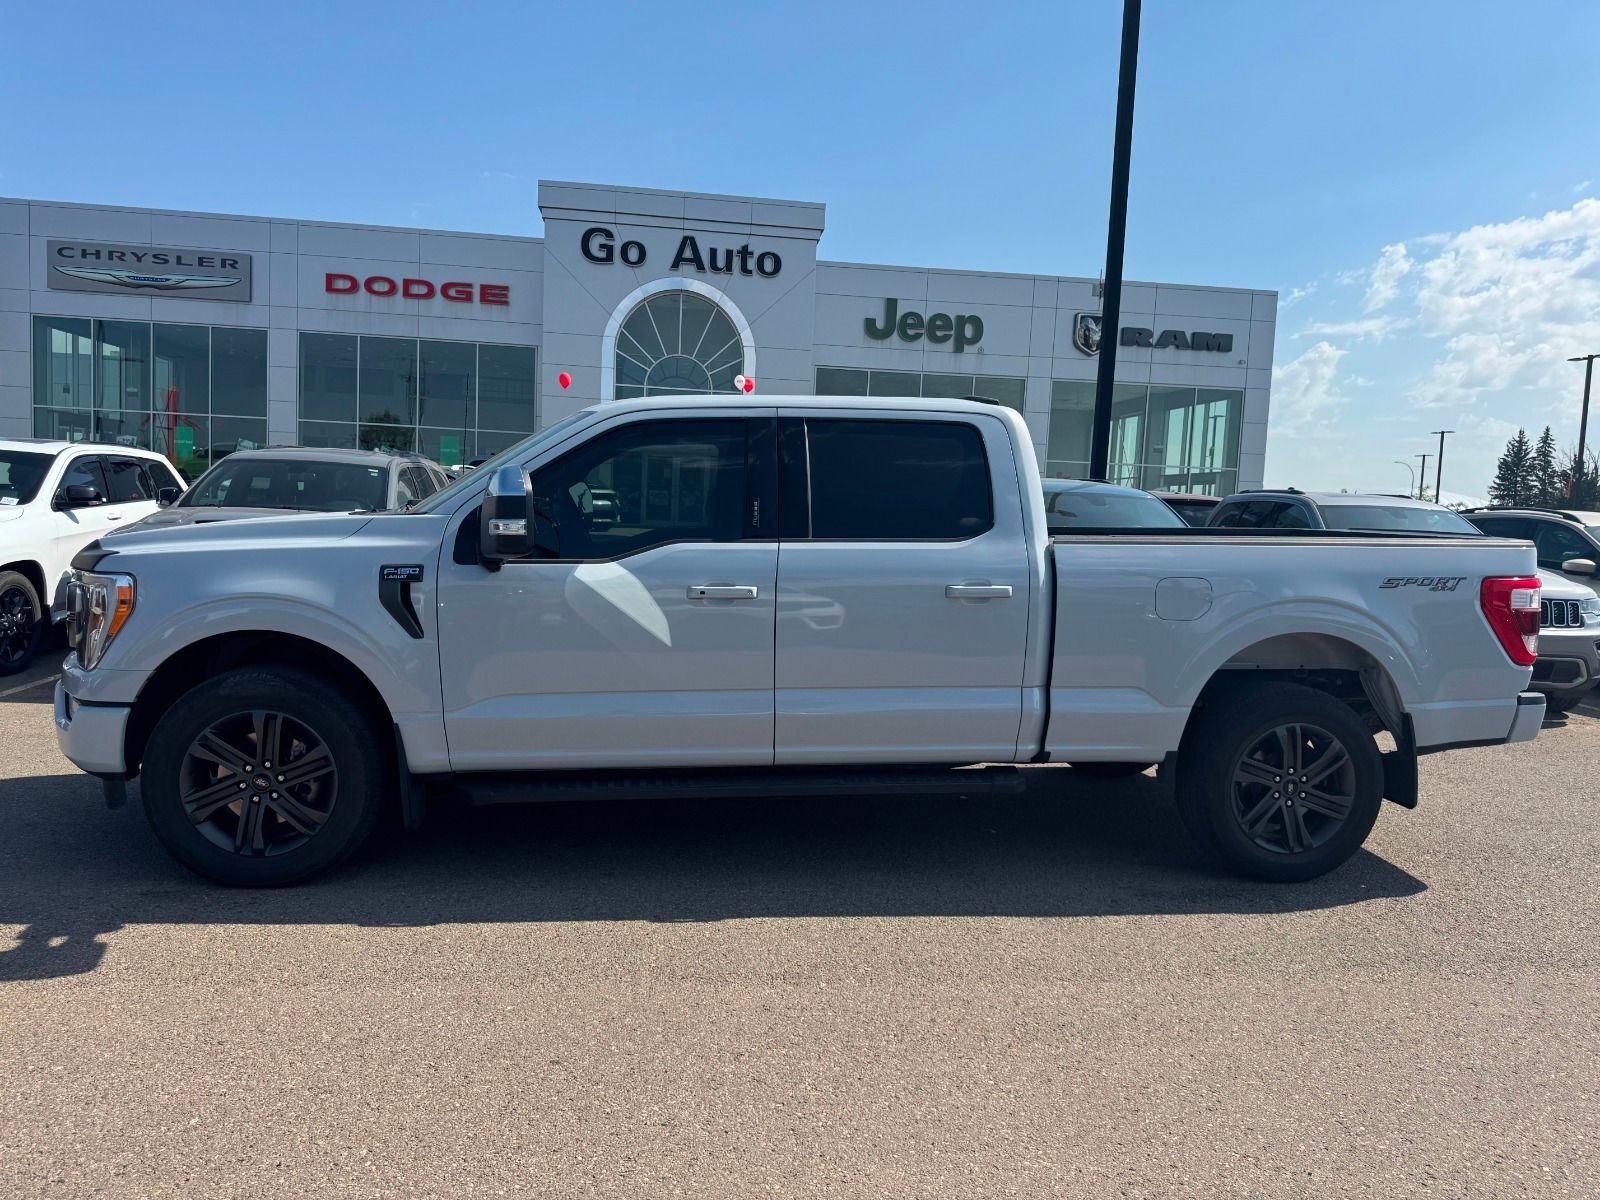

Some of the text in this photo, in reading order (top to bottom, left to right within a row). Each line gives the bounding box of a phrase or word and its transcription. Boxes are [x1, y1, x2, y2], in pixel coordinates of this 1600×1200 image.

[57, 246, 239, 269] CHRYSLER
[581, 227, 783, 278] Go Auto
[325, 273, 510, 306] DODGE
[864, 298, 984, 353] Jeep
[1120, 327, 1234, 353] RAM
[383, 567, 420, 575] F-150
[1378, 576, 1467, 589] SPORT
